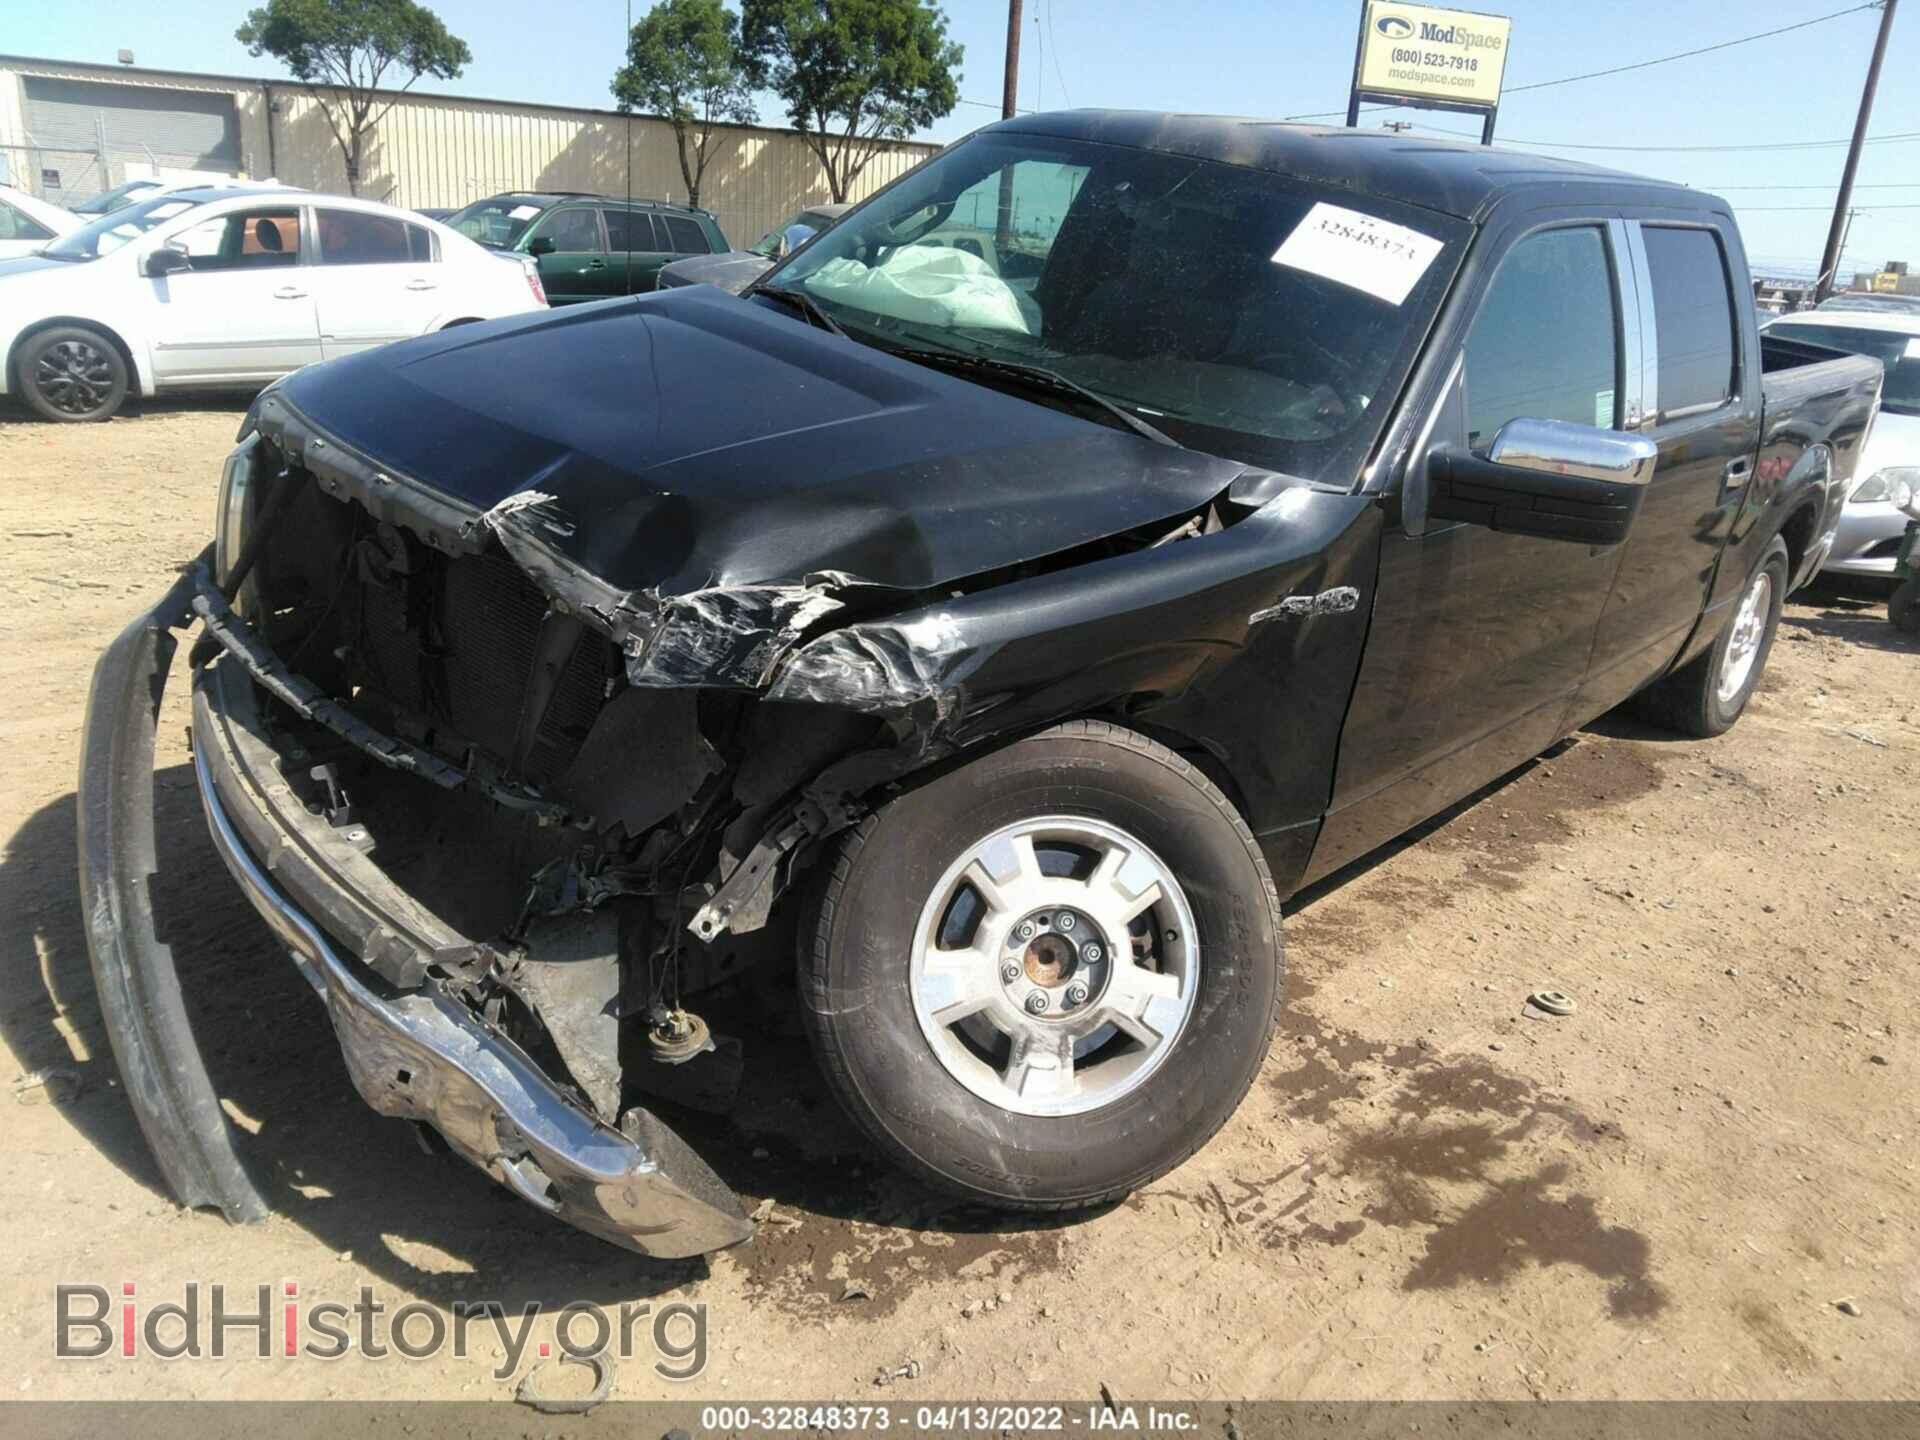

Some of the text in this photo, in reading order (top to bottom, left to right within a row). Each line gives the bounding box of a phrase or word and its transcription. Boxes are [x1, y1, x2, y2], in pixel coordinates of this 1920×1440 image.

[1419, 22, 1502, 51] ModSpace
[1391, 48, 1478, 71] (800) 523-7918
[1388, 68, 1475, 88] modspace.com
